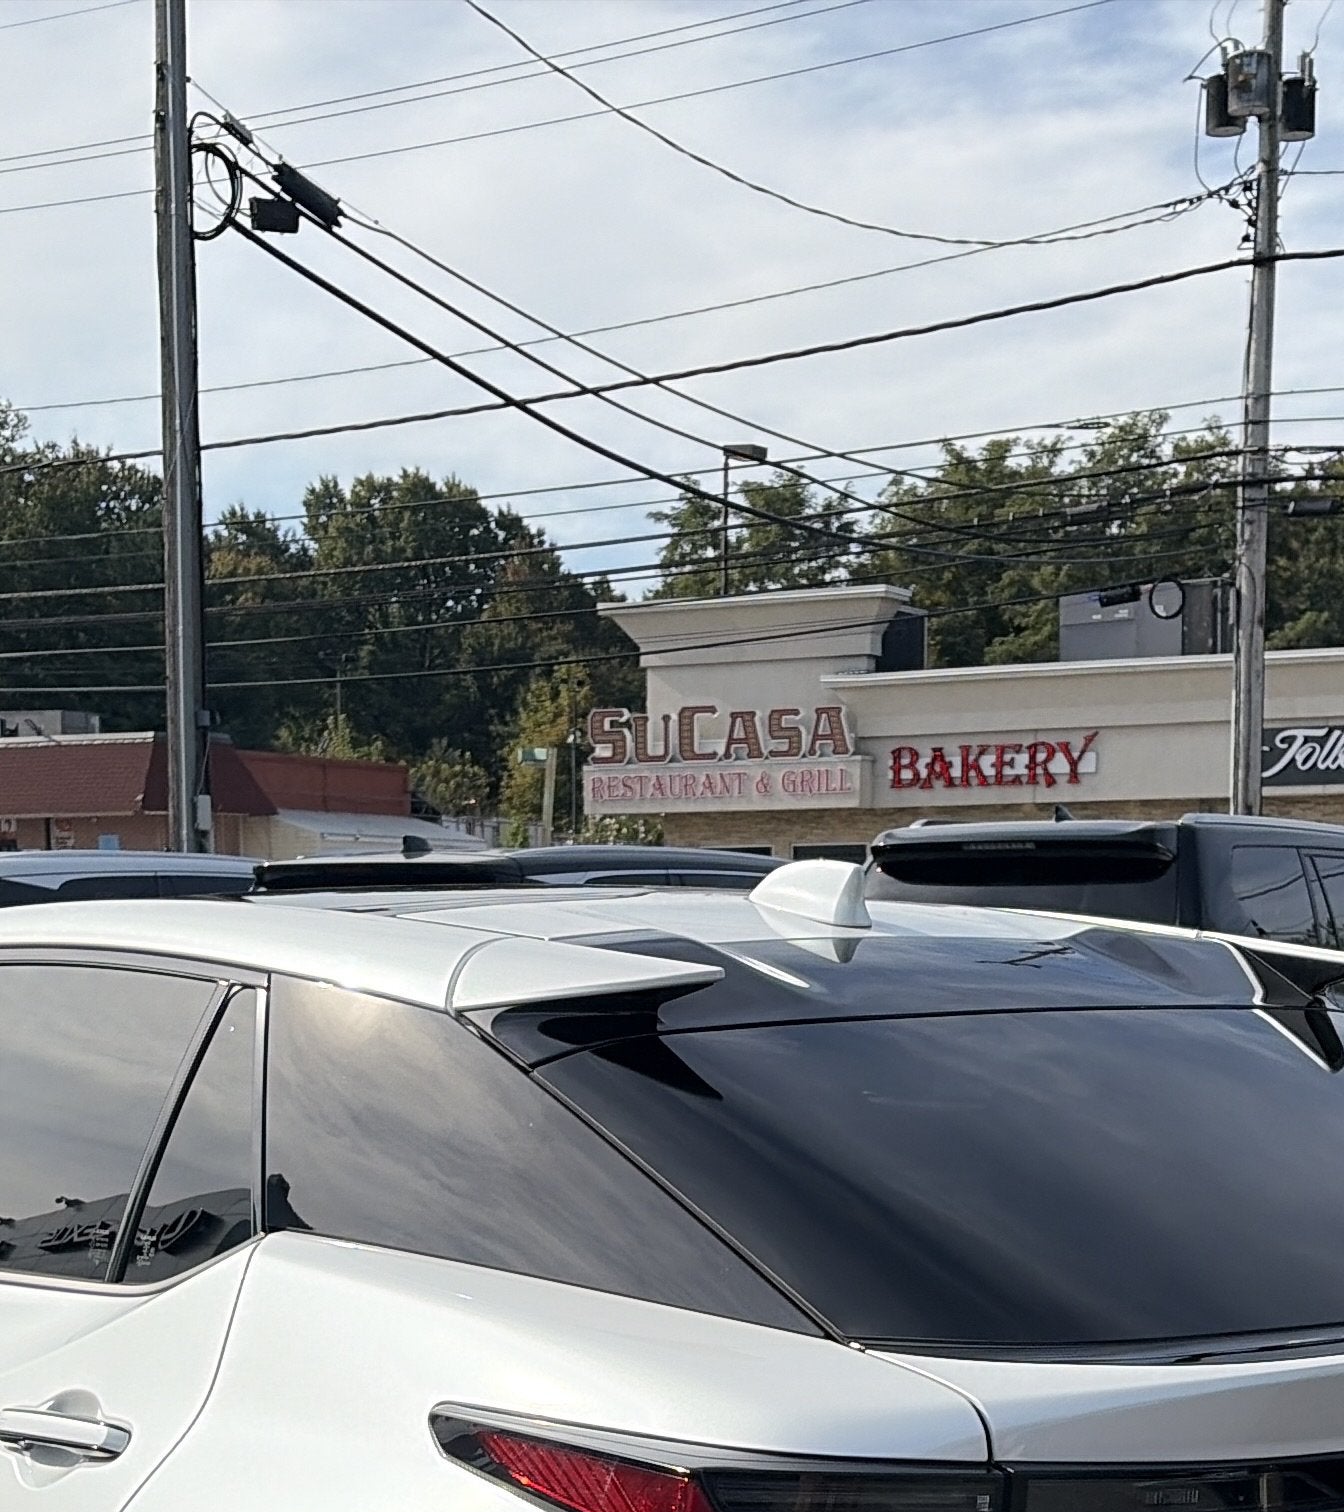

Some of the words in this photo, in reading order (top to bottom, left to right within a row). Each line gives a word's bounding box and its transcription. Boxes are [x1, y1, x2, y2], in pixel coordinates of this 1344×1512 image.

[889, 729, 1100, 790] BAKERY
[590, 771, 748, 803] RESTAURANT
[754, 770, 771, 795] &
[781, 766, 853, 796] GRILL
